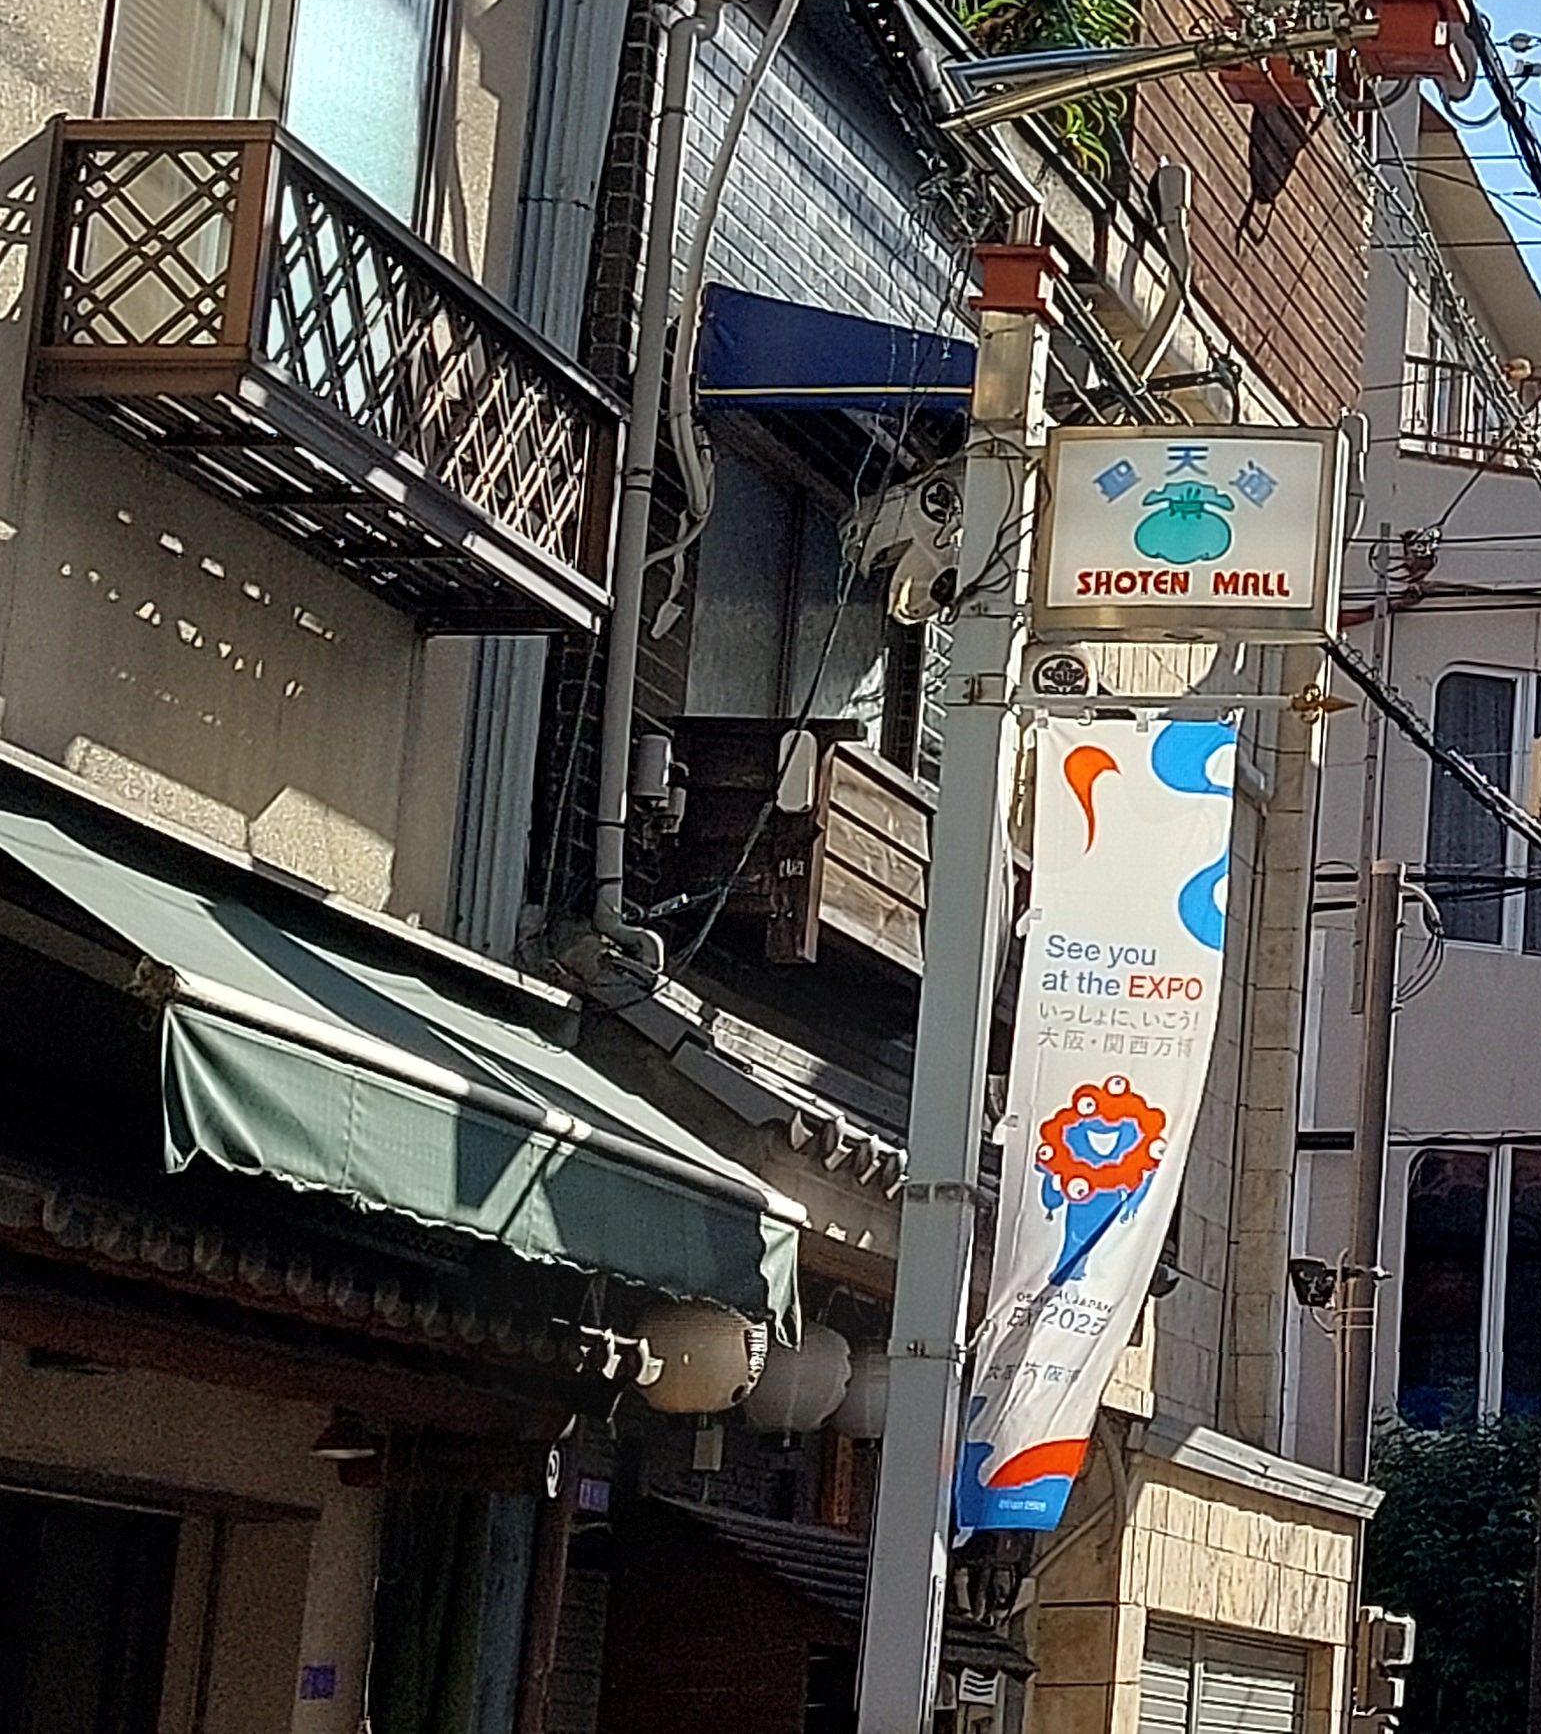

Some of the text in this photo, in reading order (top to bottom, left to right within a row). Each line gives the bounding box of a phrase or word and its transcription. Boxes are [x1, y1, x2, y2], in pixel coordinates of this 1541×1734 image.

[1076, 568, 1290, 599] SHOTEN MALL
[1045, 934, 1156, 968] See you
[1041, 970, 1203, 1000] at the EXPO
